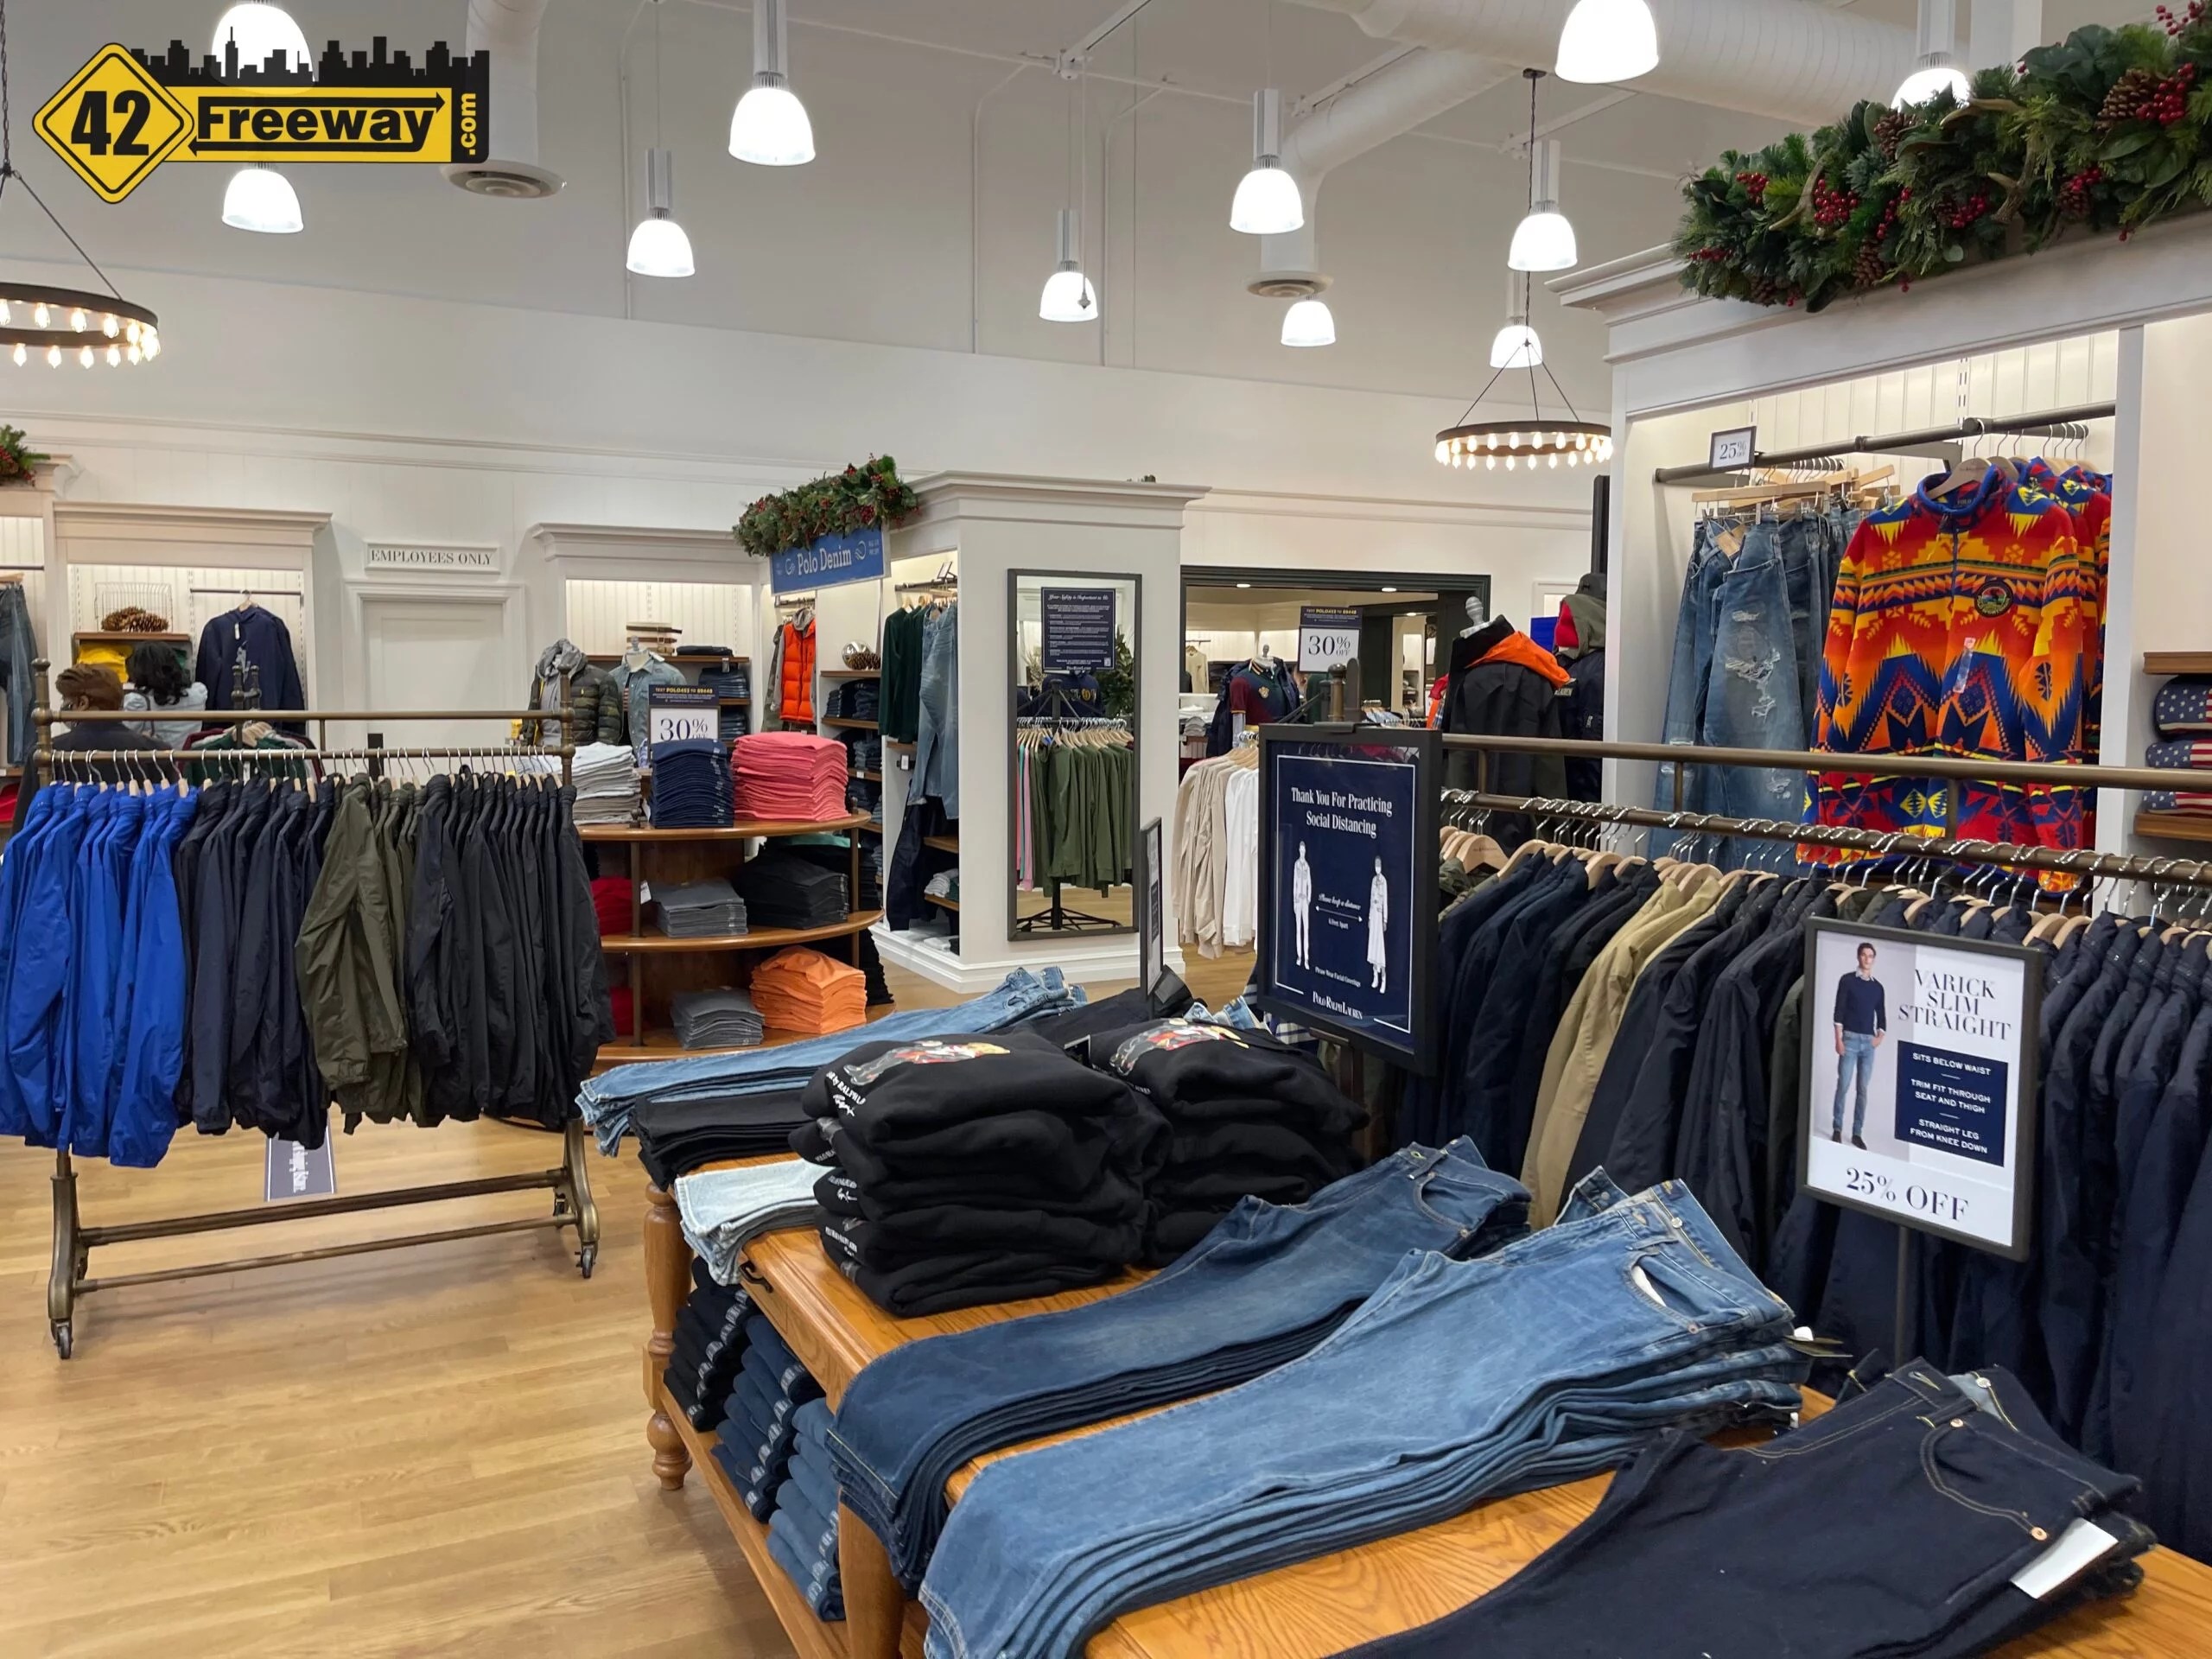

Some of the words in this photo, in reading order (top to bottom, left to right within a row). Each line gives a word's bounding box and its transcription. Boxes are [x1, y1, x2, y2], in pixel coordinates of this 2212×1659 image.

[371, 550, 454, 564] EMPLOYEES
[458, 553, 493, 565] ONLY
[797, 552, 818, 575] Polo
[820, 544, 852, 570] Denim
[1308, 635, 1351, 656] 30%
[660, 718, 708, 741] 30%
[1291, 787, 1314, 804] Thank
[1315, 790, 1330, 806] You
[1332, 791, 1346, 808] For
[1348, 793, 1393, 817] Practicing
[1306, 810, 1330, 829] Social
[1332, 814, 1376, 839] Distancing
[1915, 969, 1996, 1000] VARICK
[1927, 990, 1979, 1015] SLIM
[1897, 1004, 2012, 1040] STRAIGHT
[1912, 1052, 1932, 1063] SITS
[1933, 1057, 1963, 1070] BELOW
[1964, 1064, 1992, 1075] WAIST
[1910, 1078, 1931, 1090] TRIM
[1932, 1084, 1946, 1093] FIT
[1948, 1087, 1991, 1103] THROUGH
[1915, 1090, 1937, 1102] SEAT
[1938, 1096, 1957, 1107] AND
[1958, 1101, 1986, 1114] THIGH
[1910, 1127, 1935, 1140] FROM
[1936, 1135, 1960, 1147] KNEE
[1961, 1141, 1988, 1154] DOWN
[1918, 1118, 1961, 1135] STRAIGHT
[1962, 1130, 1980, 1141] LEG
[1846, 1167, 1897, 1203] 25%
[1906, 1185, 1969, 1222] OFF
